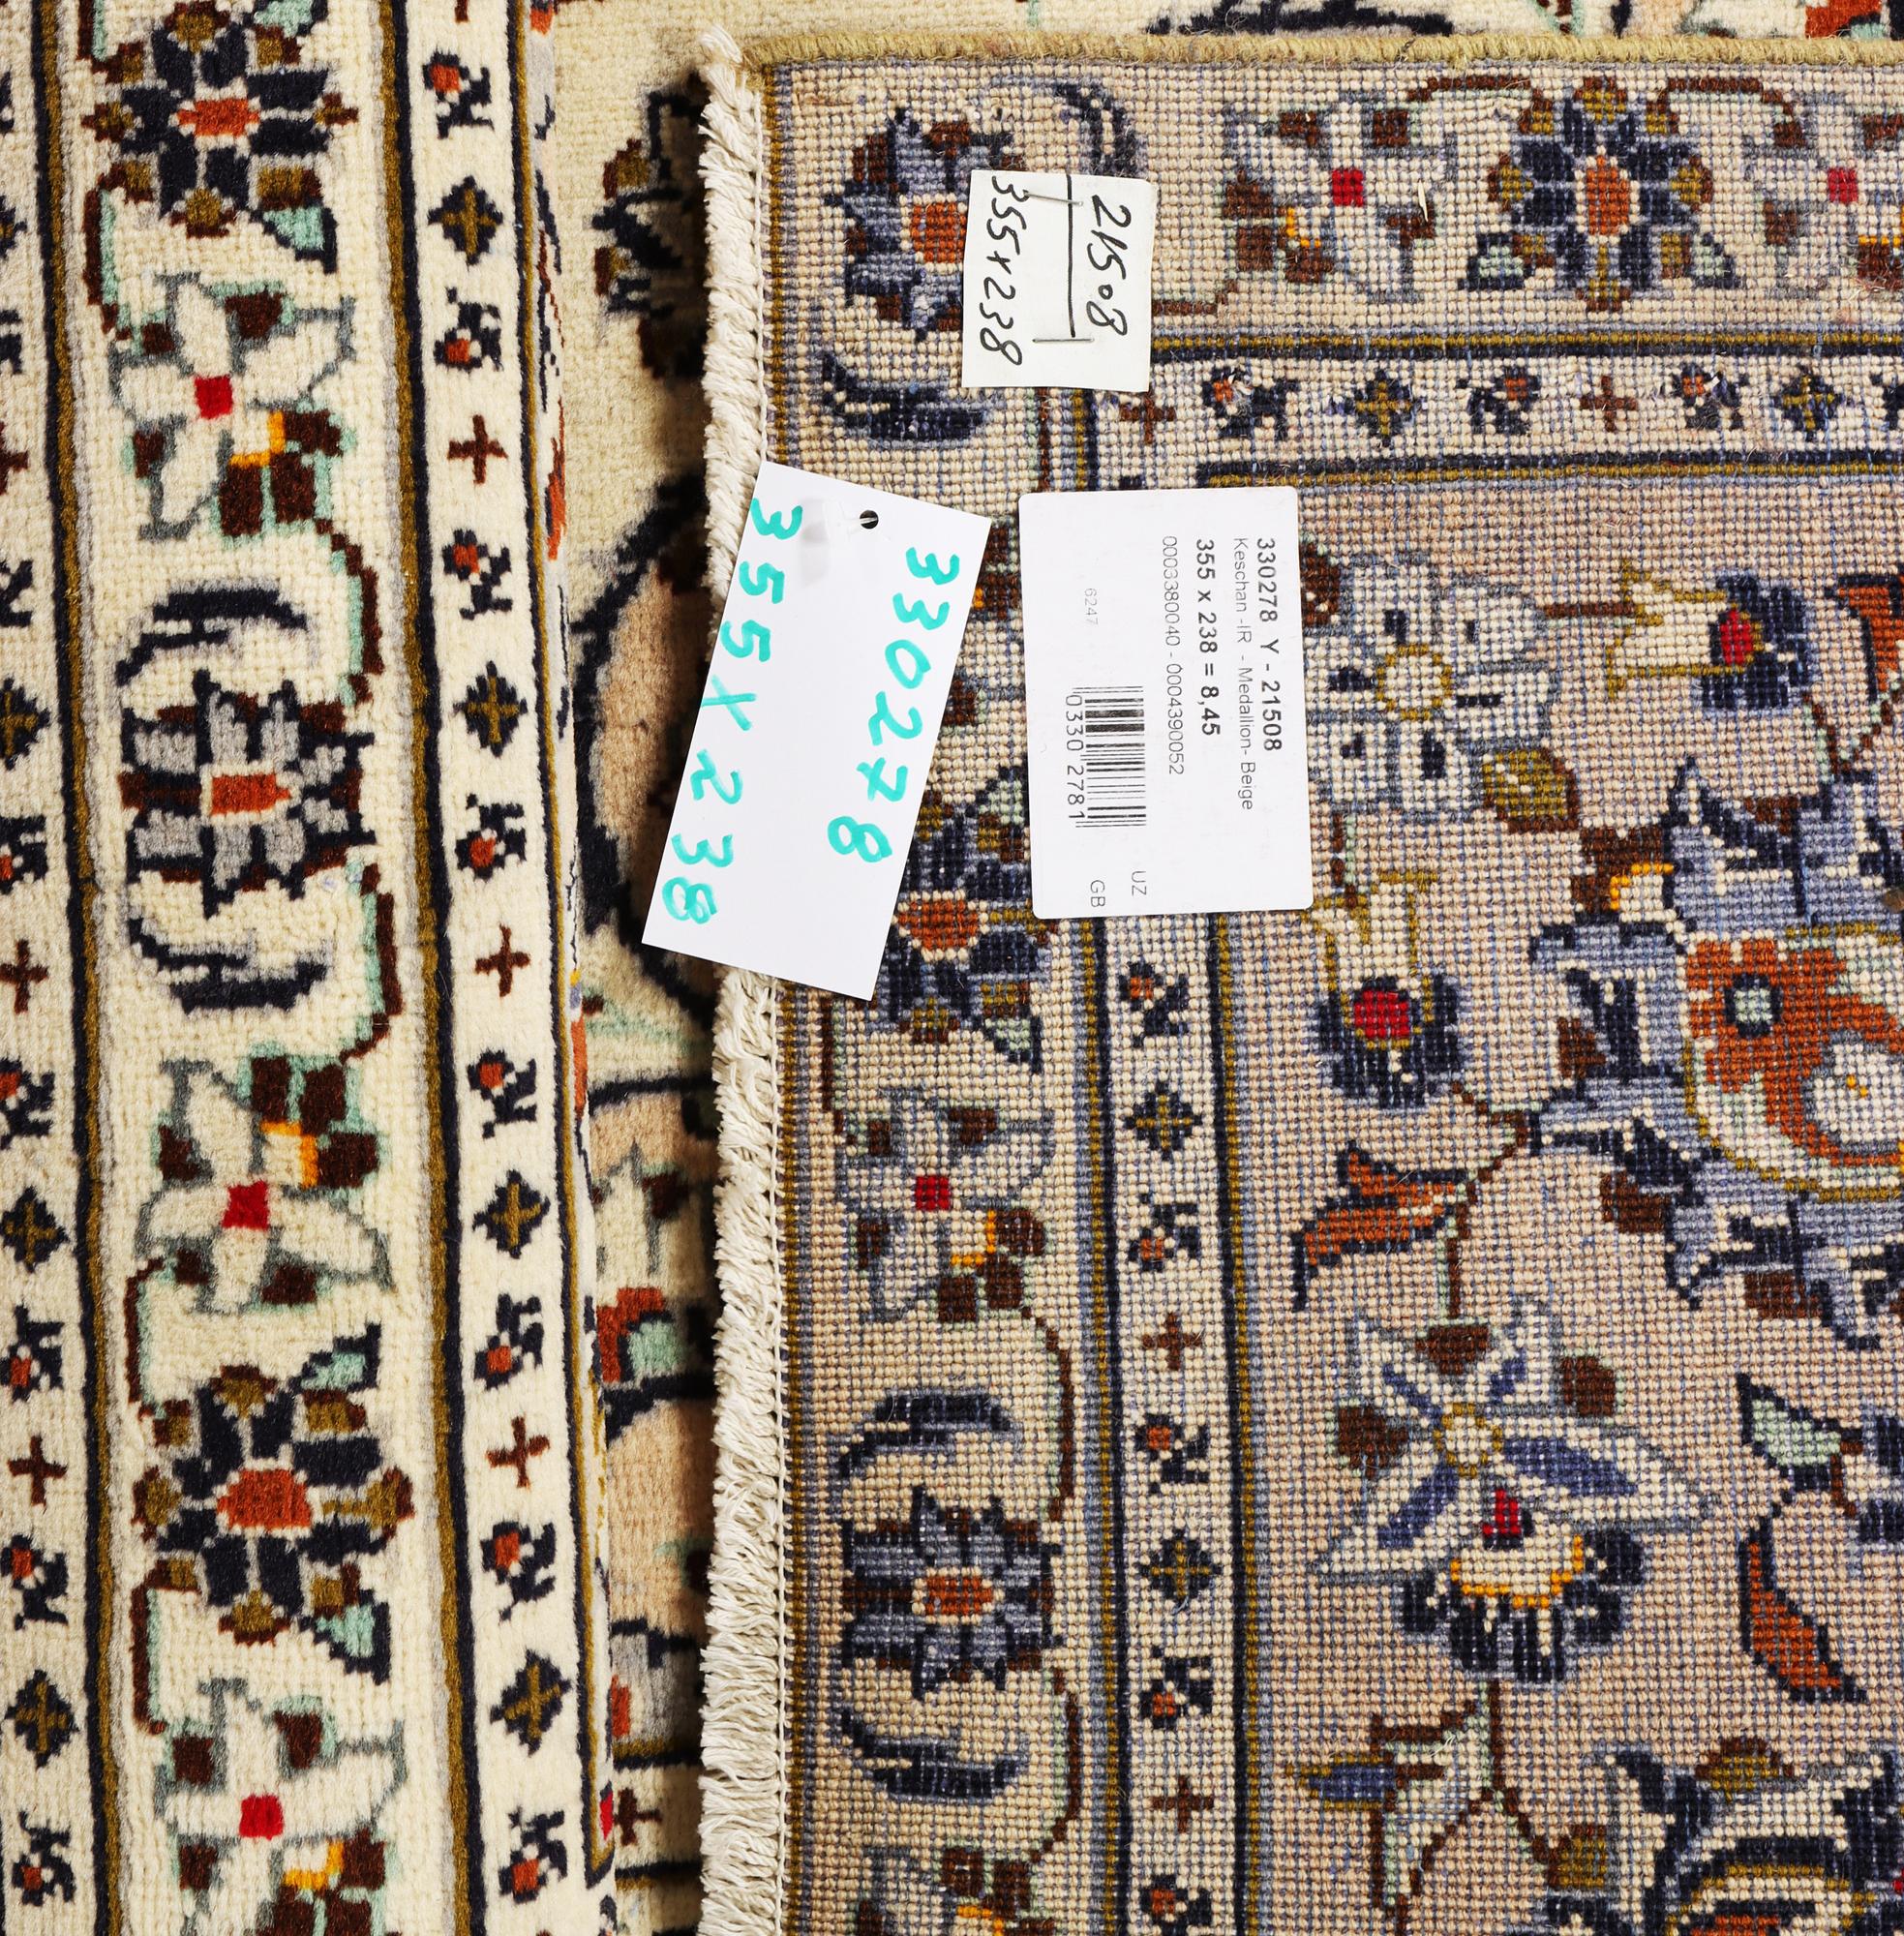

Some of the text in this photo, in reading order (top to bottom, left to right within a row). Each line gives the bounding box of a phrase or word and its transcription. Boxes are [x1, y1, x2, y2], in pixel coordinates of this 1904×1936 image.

[1086, 195, 1131, 335] 21508
[1196, 539, 1215, 579] 355
[1234, 538, 1250, 612] Keschan
[1257, 538, 1278, 621] 330278
[1084, 589, 1098, 624] 6247
[1163, 536, 1180, 646] 0003380040
[1198, 590, 1211, 602] x
[1198, 612, 1218, 652] 238
[1260, 639, 1279, 653] Y
[828, 548, 959, 862] 330278
[1166, 664, 1184, 774] 0004390052
[1197, 686, 1221, 735] 8,45
[1261, 681, 1283, 750] 21508
[1238, 763, 1255, 809] Beige
[1091, 880, 1105, 907] GB
[1132, 871, 1146, 895] UZ
